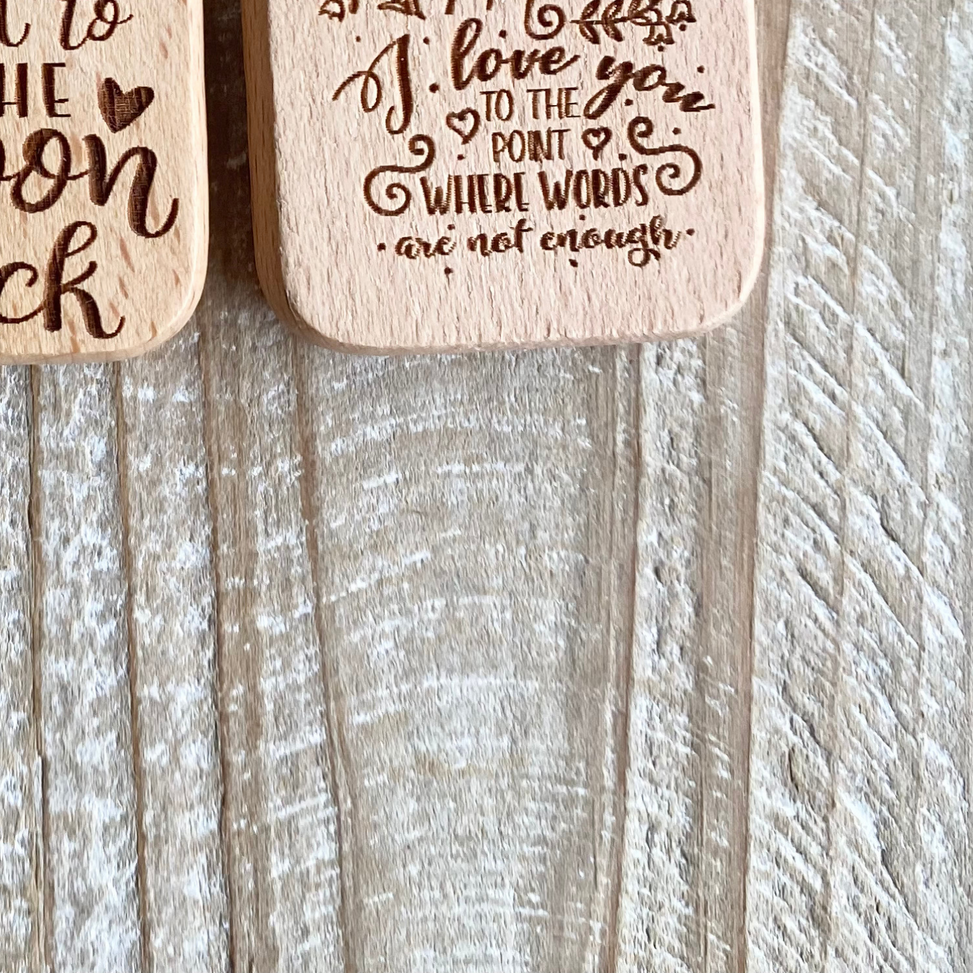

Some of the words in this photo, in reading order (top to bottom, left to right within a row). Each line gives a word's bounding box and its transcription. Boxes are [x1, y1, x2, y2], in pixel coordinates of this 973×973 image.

[332, 34, 412, 135] I
[450, 18, 582, 91] love
[584, 53, 716, 120] you
[480, 89, 514, 121] TO
[526, 87, 584, 119] THE
[491, 128, 571, 163] POINT
[420, 172, 529, 216] WHERE
[538, 163, 651, 210] WORDS
[395, 232, 457, 260] are
[468, 218, 534, 257] not
[540, 214, 682, 268] enough
